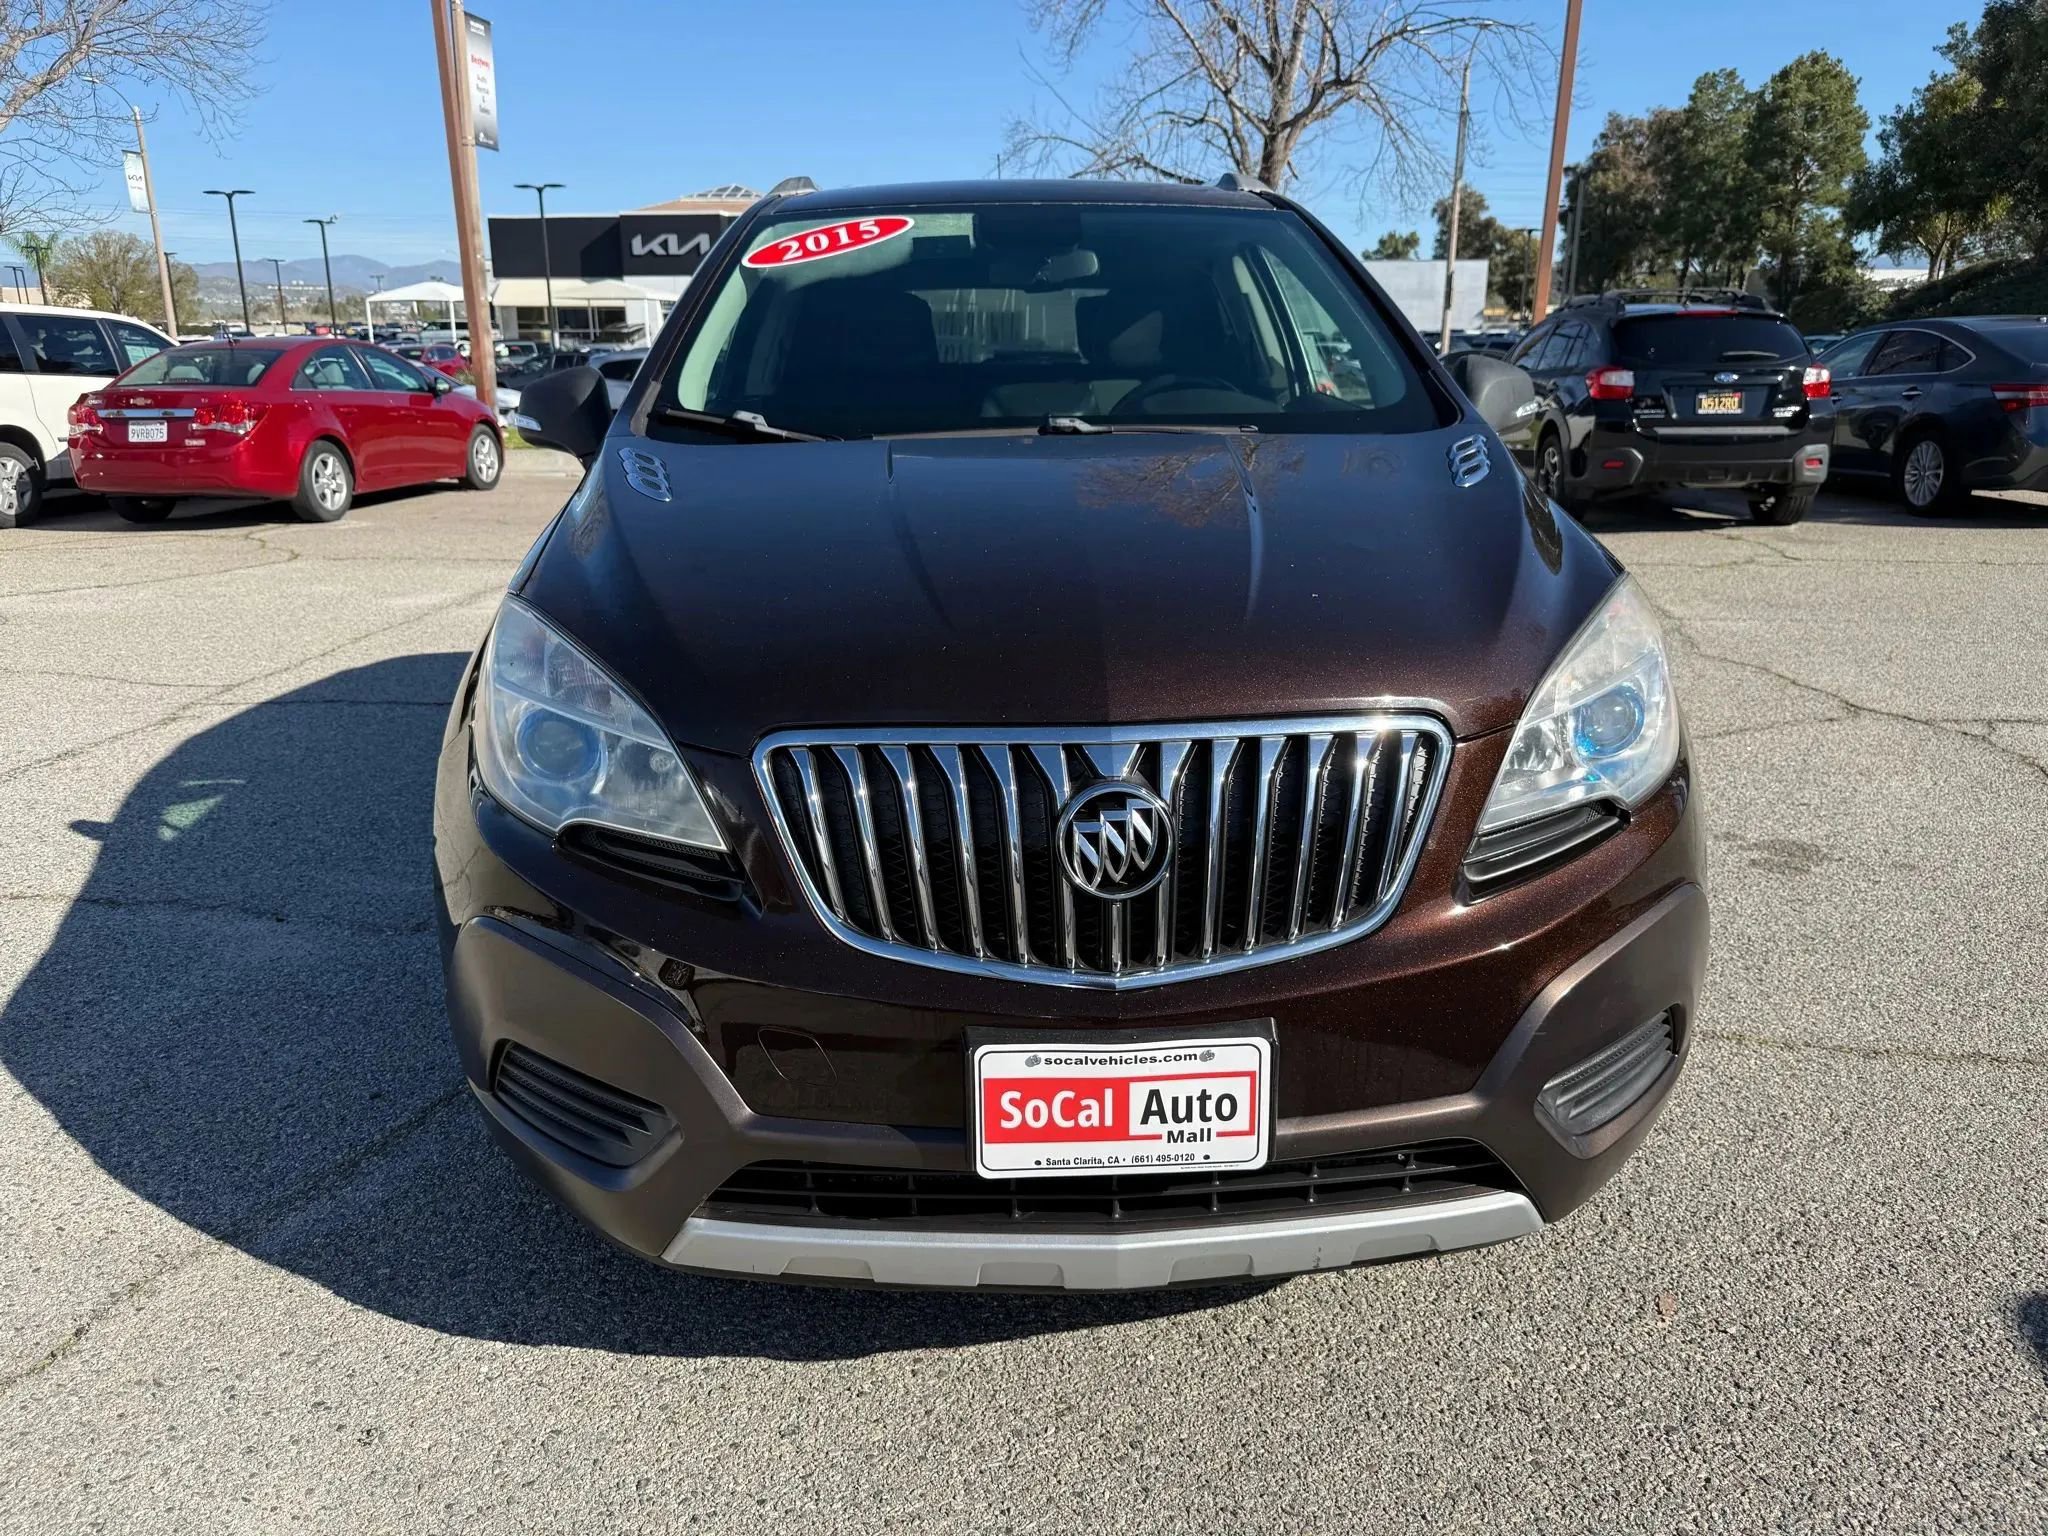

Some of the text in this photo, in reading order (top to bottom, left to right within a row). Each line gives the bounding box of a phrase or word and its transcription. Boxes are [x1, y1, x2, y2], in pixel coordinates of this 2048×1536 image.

[631, 232, 711, 256] KIA
[778, 220, 881, 261] 2015
[1044, 1053, 1198, 1066] socalvehicles.com
[1000, 1088, 1238, 1129] SoCal Auto
[1166, 1128, 1212, 1144] Mall
[1046, 1152, 1195, 1167] Santa Clarita, CA (661) 495-0120
